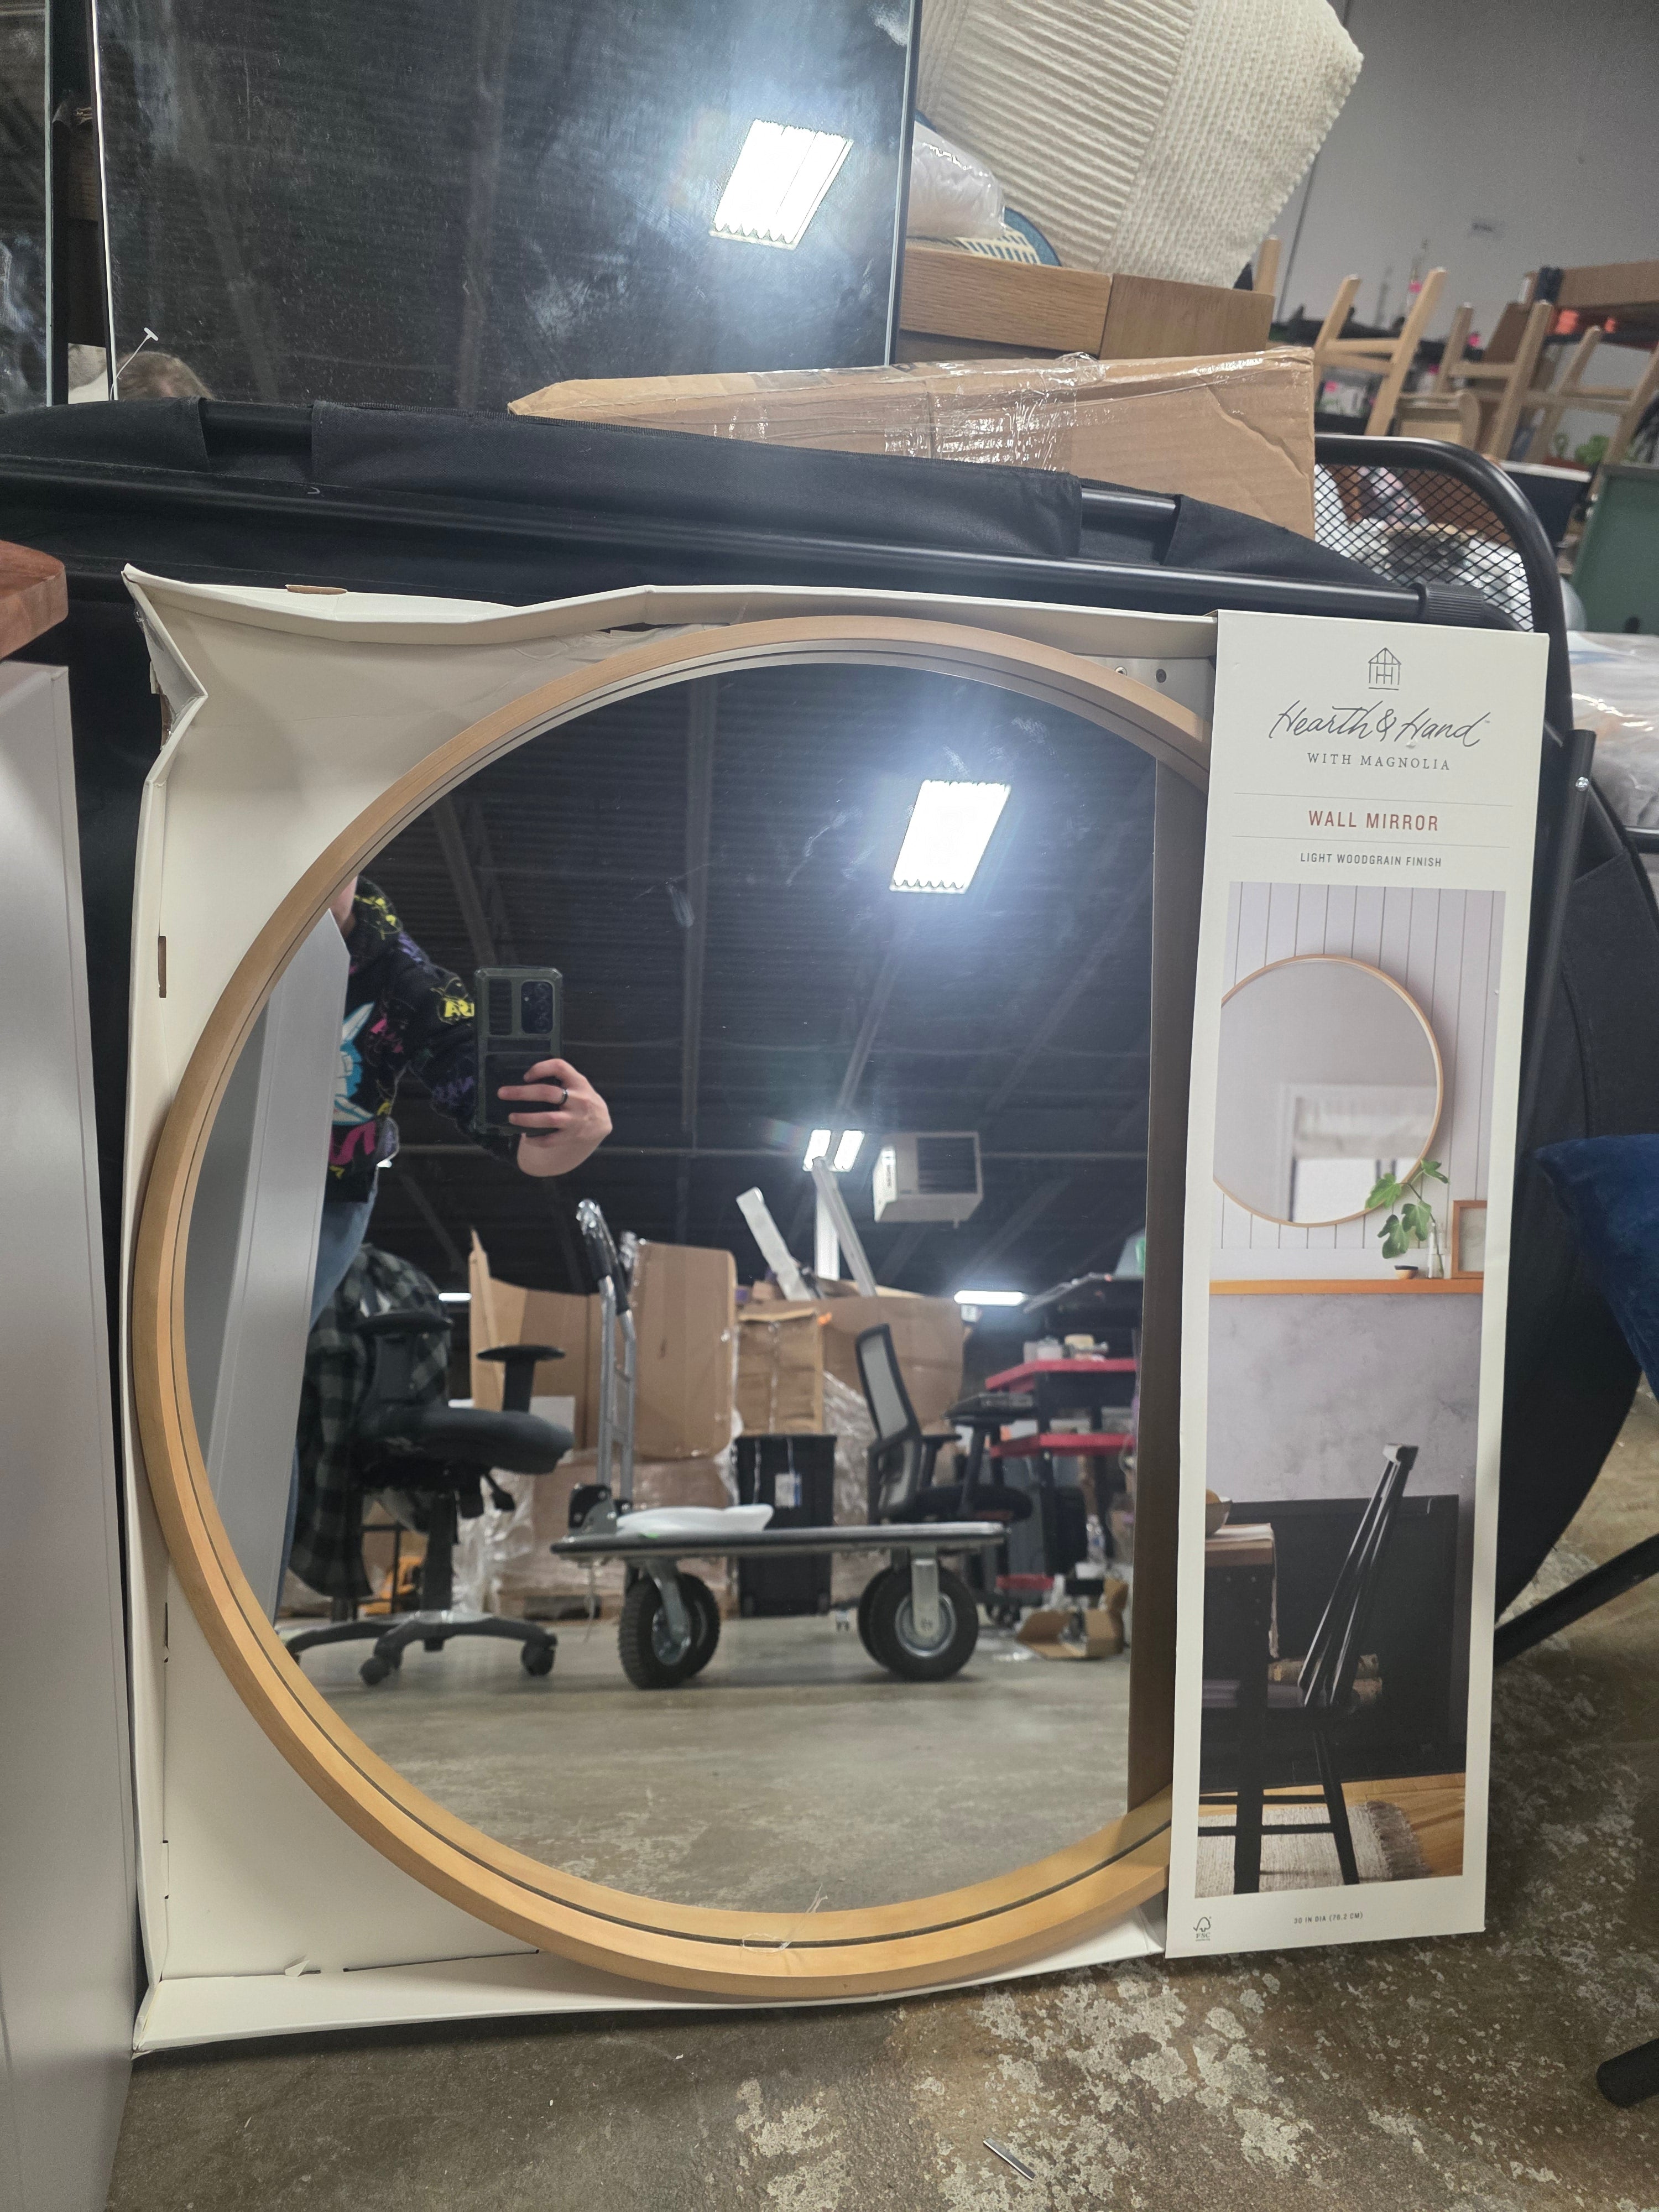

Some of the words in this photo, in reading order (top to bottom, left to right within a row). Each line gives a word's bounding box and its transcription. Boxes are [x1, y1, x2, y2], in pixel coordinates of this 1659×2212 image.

[1269, 700, 1383, 739] Hearth
[1376, 708, 1397, 742] &
[1394, 707, 1491, 747] Hand
[1307, 752, 1352, 765] WITH
[1359, 755, 1450, 770] MAGNOLIA
[1308, 810, 1357, 828] WALL
[1366, 812, 1438, 831] MIRROR
[1300, 852, 1333, 863] LIGHT
[1337, 853, 1402, 866] WOODGRAIN
[1406, 856, 1442, 867] FINISH
[1314, 1914, 1327, 1923] DIA
[1349, 1911, 1364, 1920] CM)
